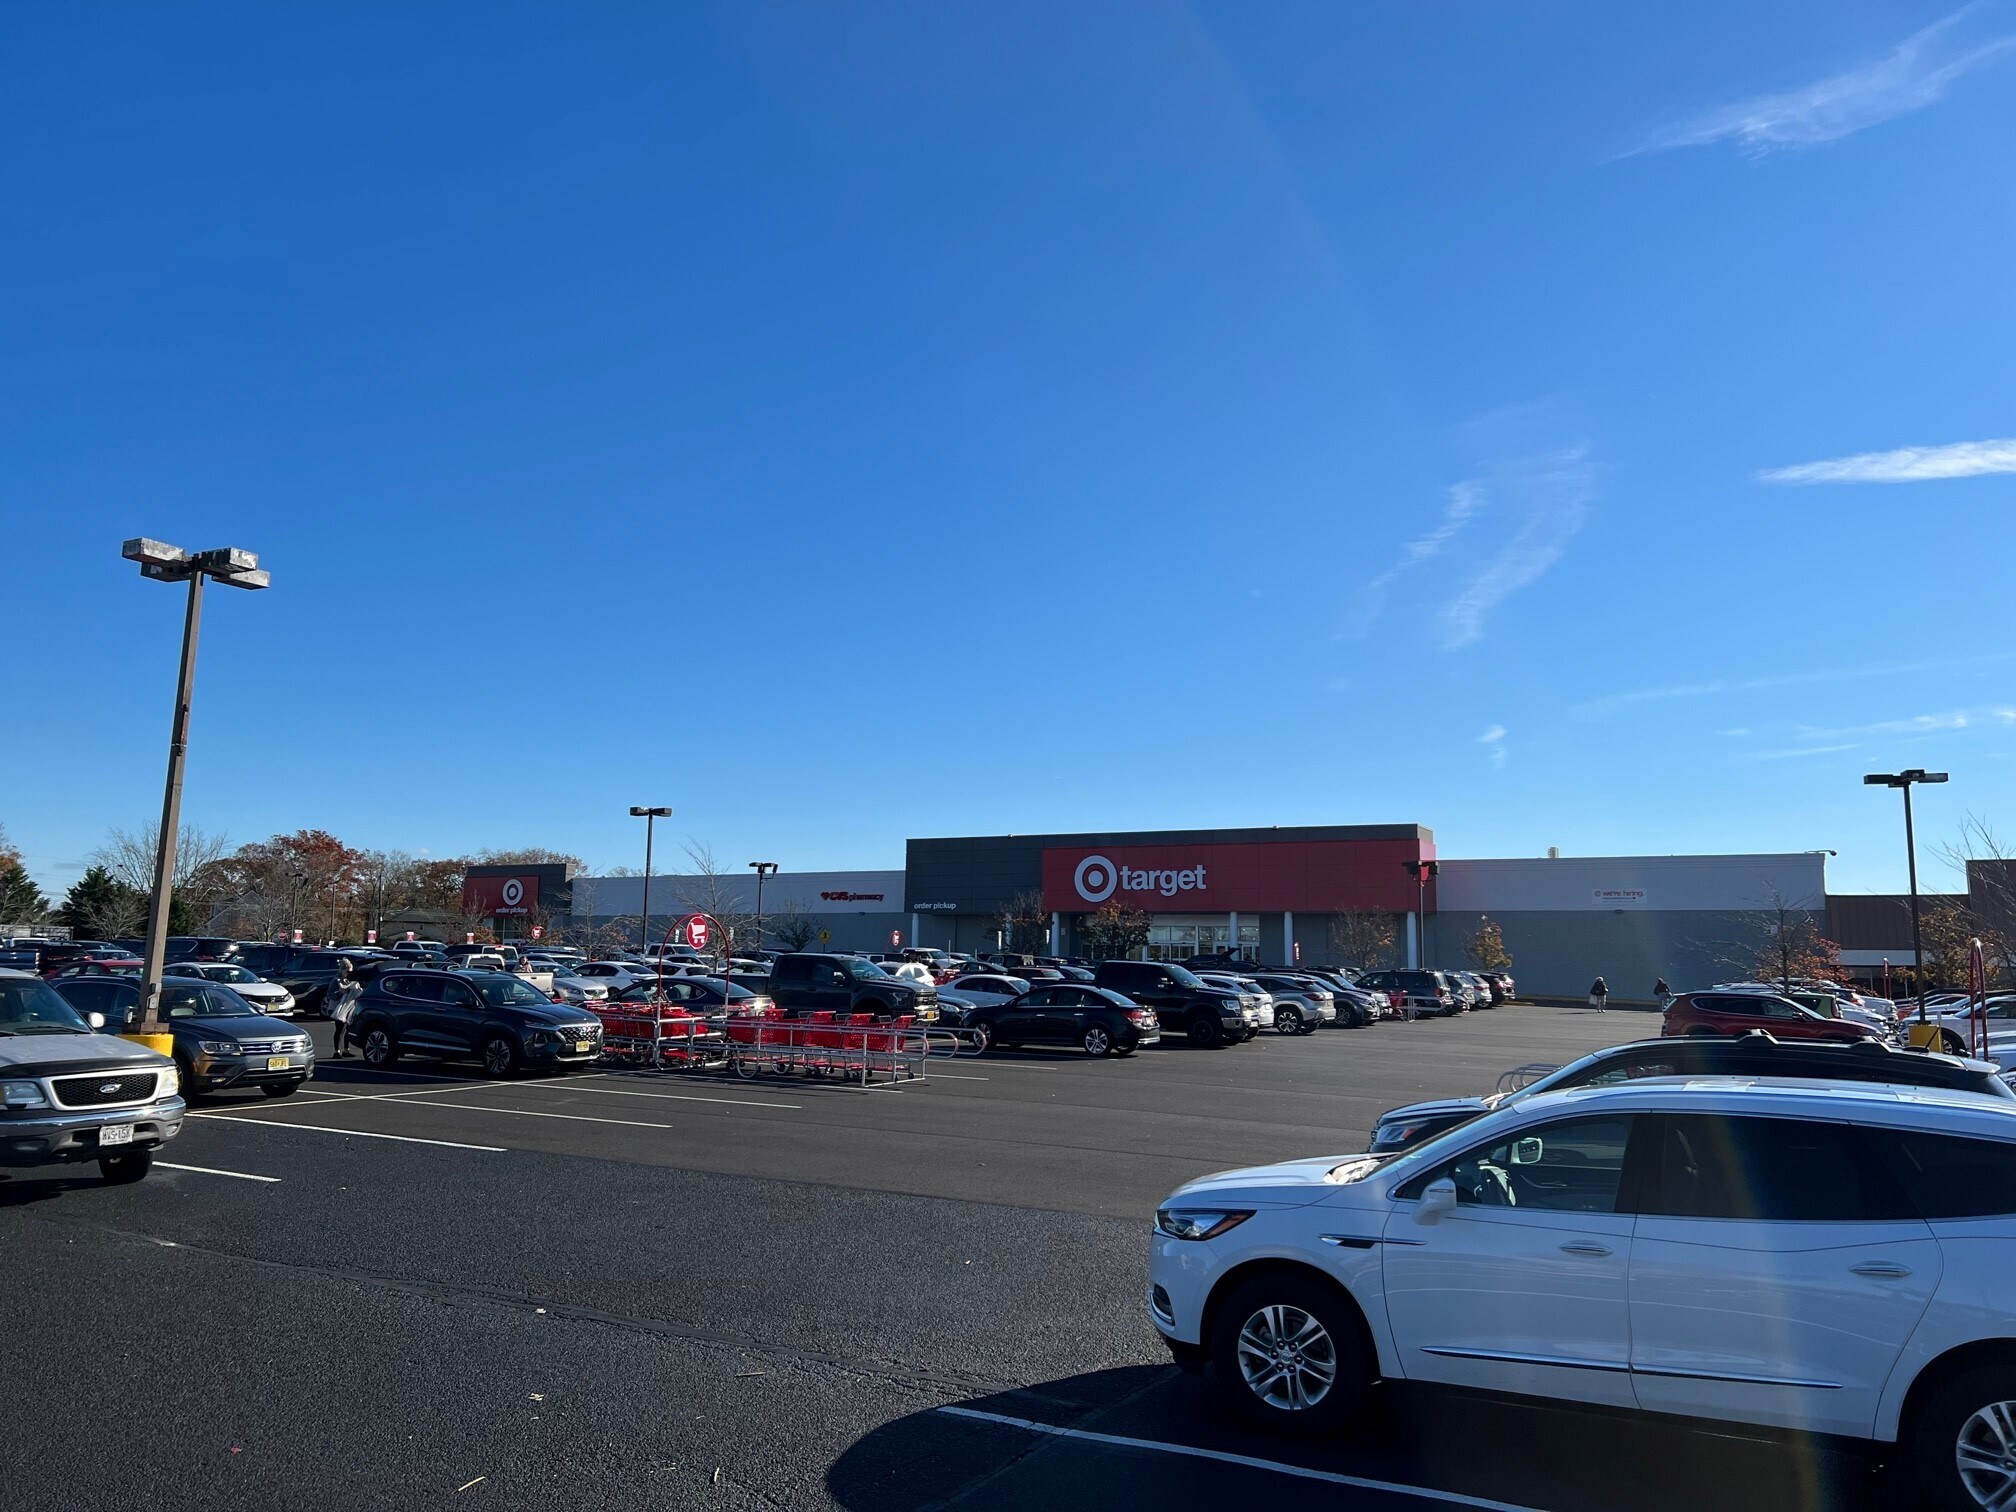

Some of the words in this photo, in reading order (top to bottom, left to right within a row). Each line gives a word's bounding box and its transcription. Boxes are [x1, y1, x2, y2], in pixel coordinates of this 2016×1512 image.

[1120, 865, 1206, 896] target
[830, 891, 848, 901] CVS
[849, 892, 884, 902] pharmacy
[933, 902, 956, 910] pickup
